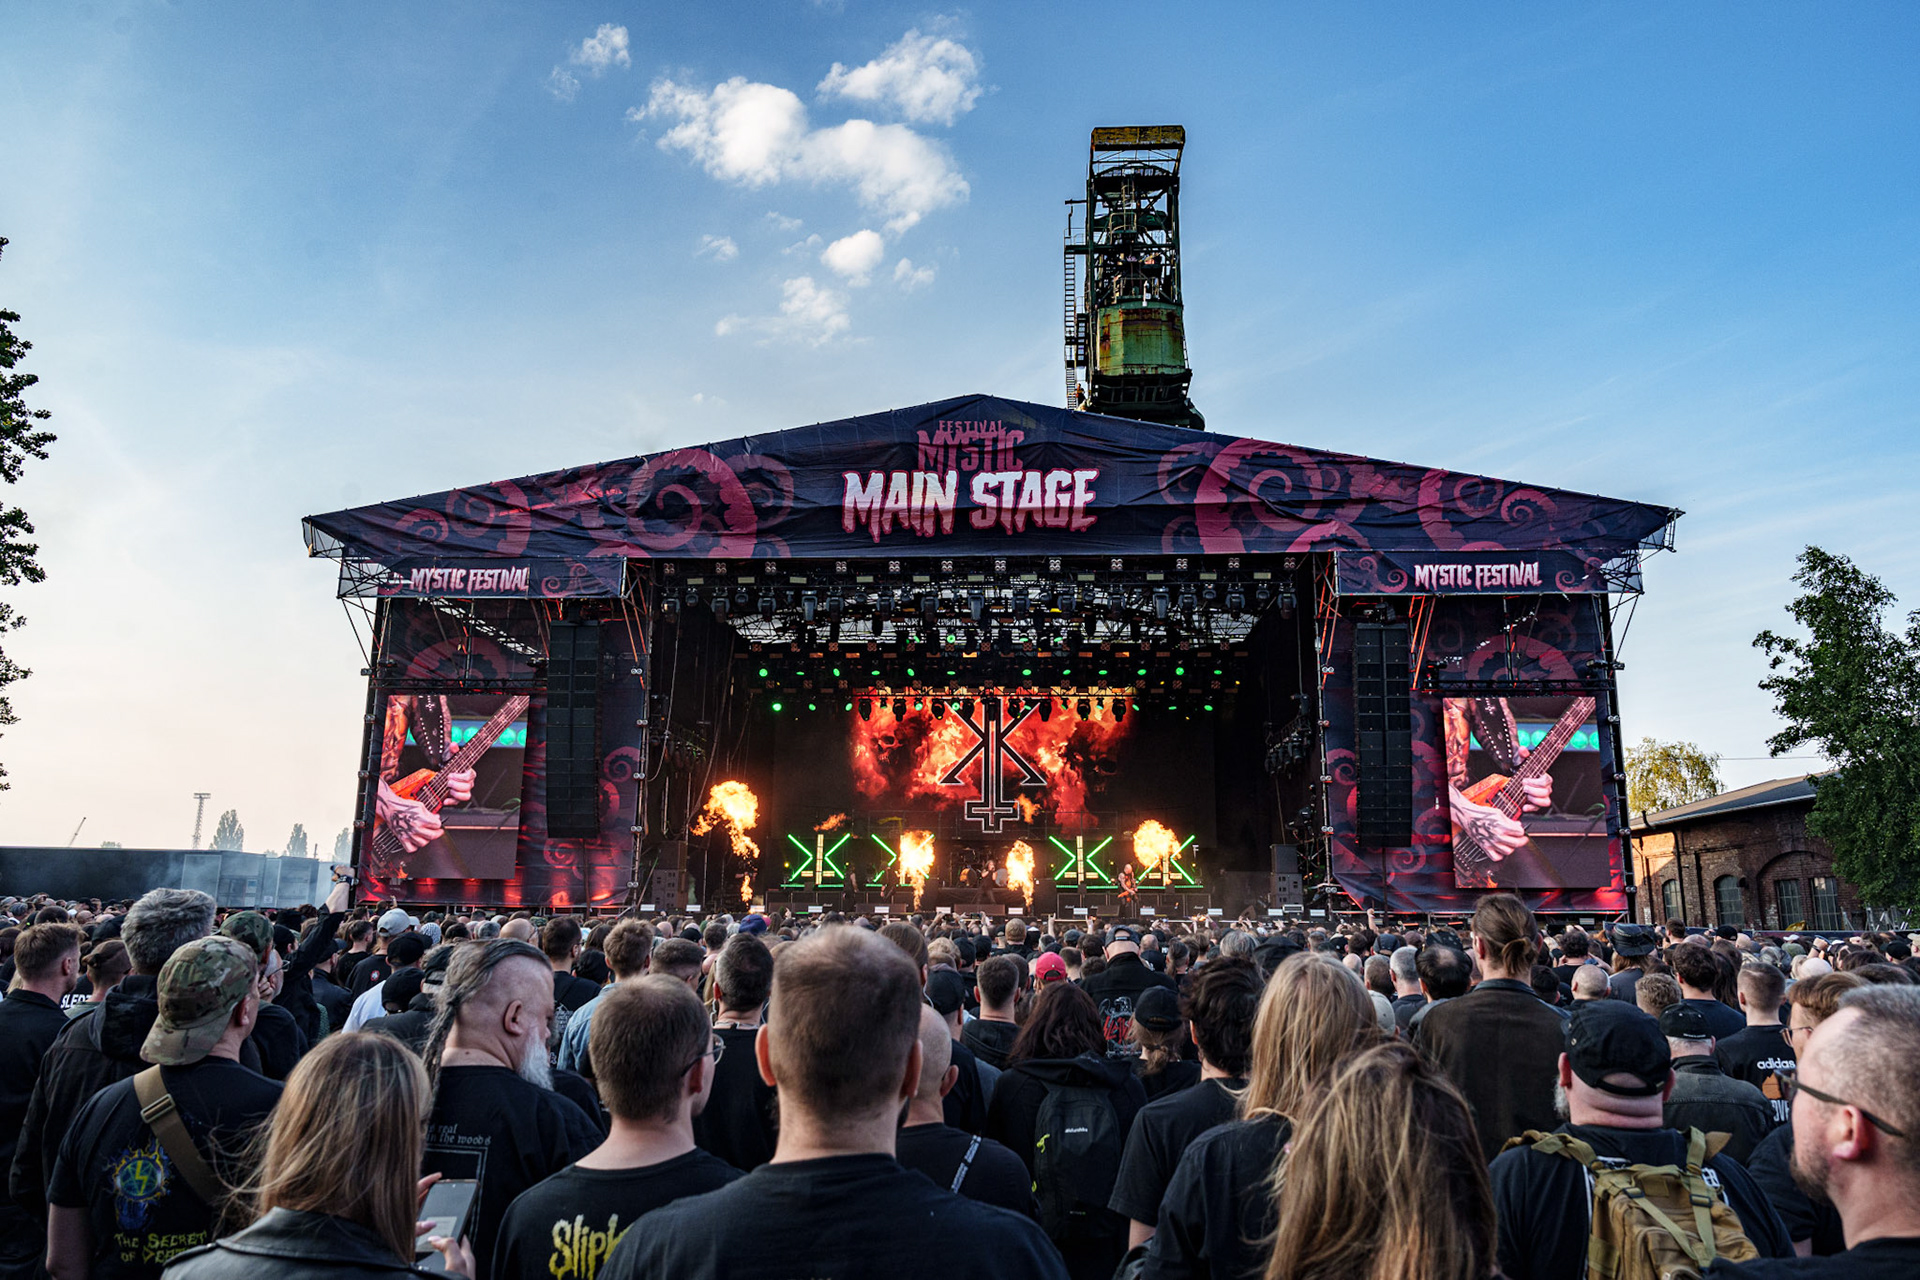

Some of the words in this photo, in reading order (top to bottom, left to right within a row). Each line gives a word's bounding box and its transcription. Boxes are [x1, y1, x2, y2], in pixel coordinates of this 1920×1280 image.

[938, 419, 1007, 433] FESTIVAL
[916, 429, 1025, 476] MYSTIC
[842, 469, 959, 543] MAIN
[969, 468, 1100, 535] STAGE
[409, 567, 467, 594] MYSTIC
[467, 565, 529, 595] FESTIVAL
[1413, 564, 1473, 591] MYSTIC
[1474, 560, 1543, 592] FESTIVAL
[1757, 1057, 1796, 1070] adidas
[113, 1232, 140, 1249] THE
[147, 1229, 208, 1250] SECRET
